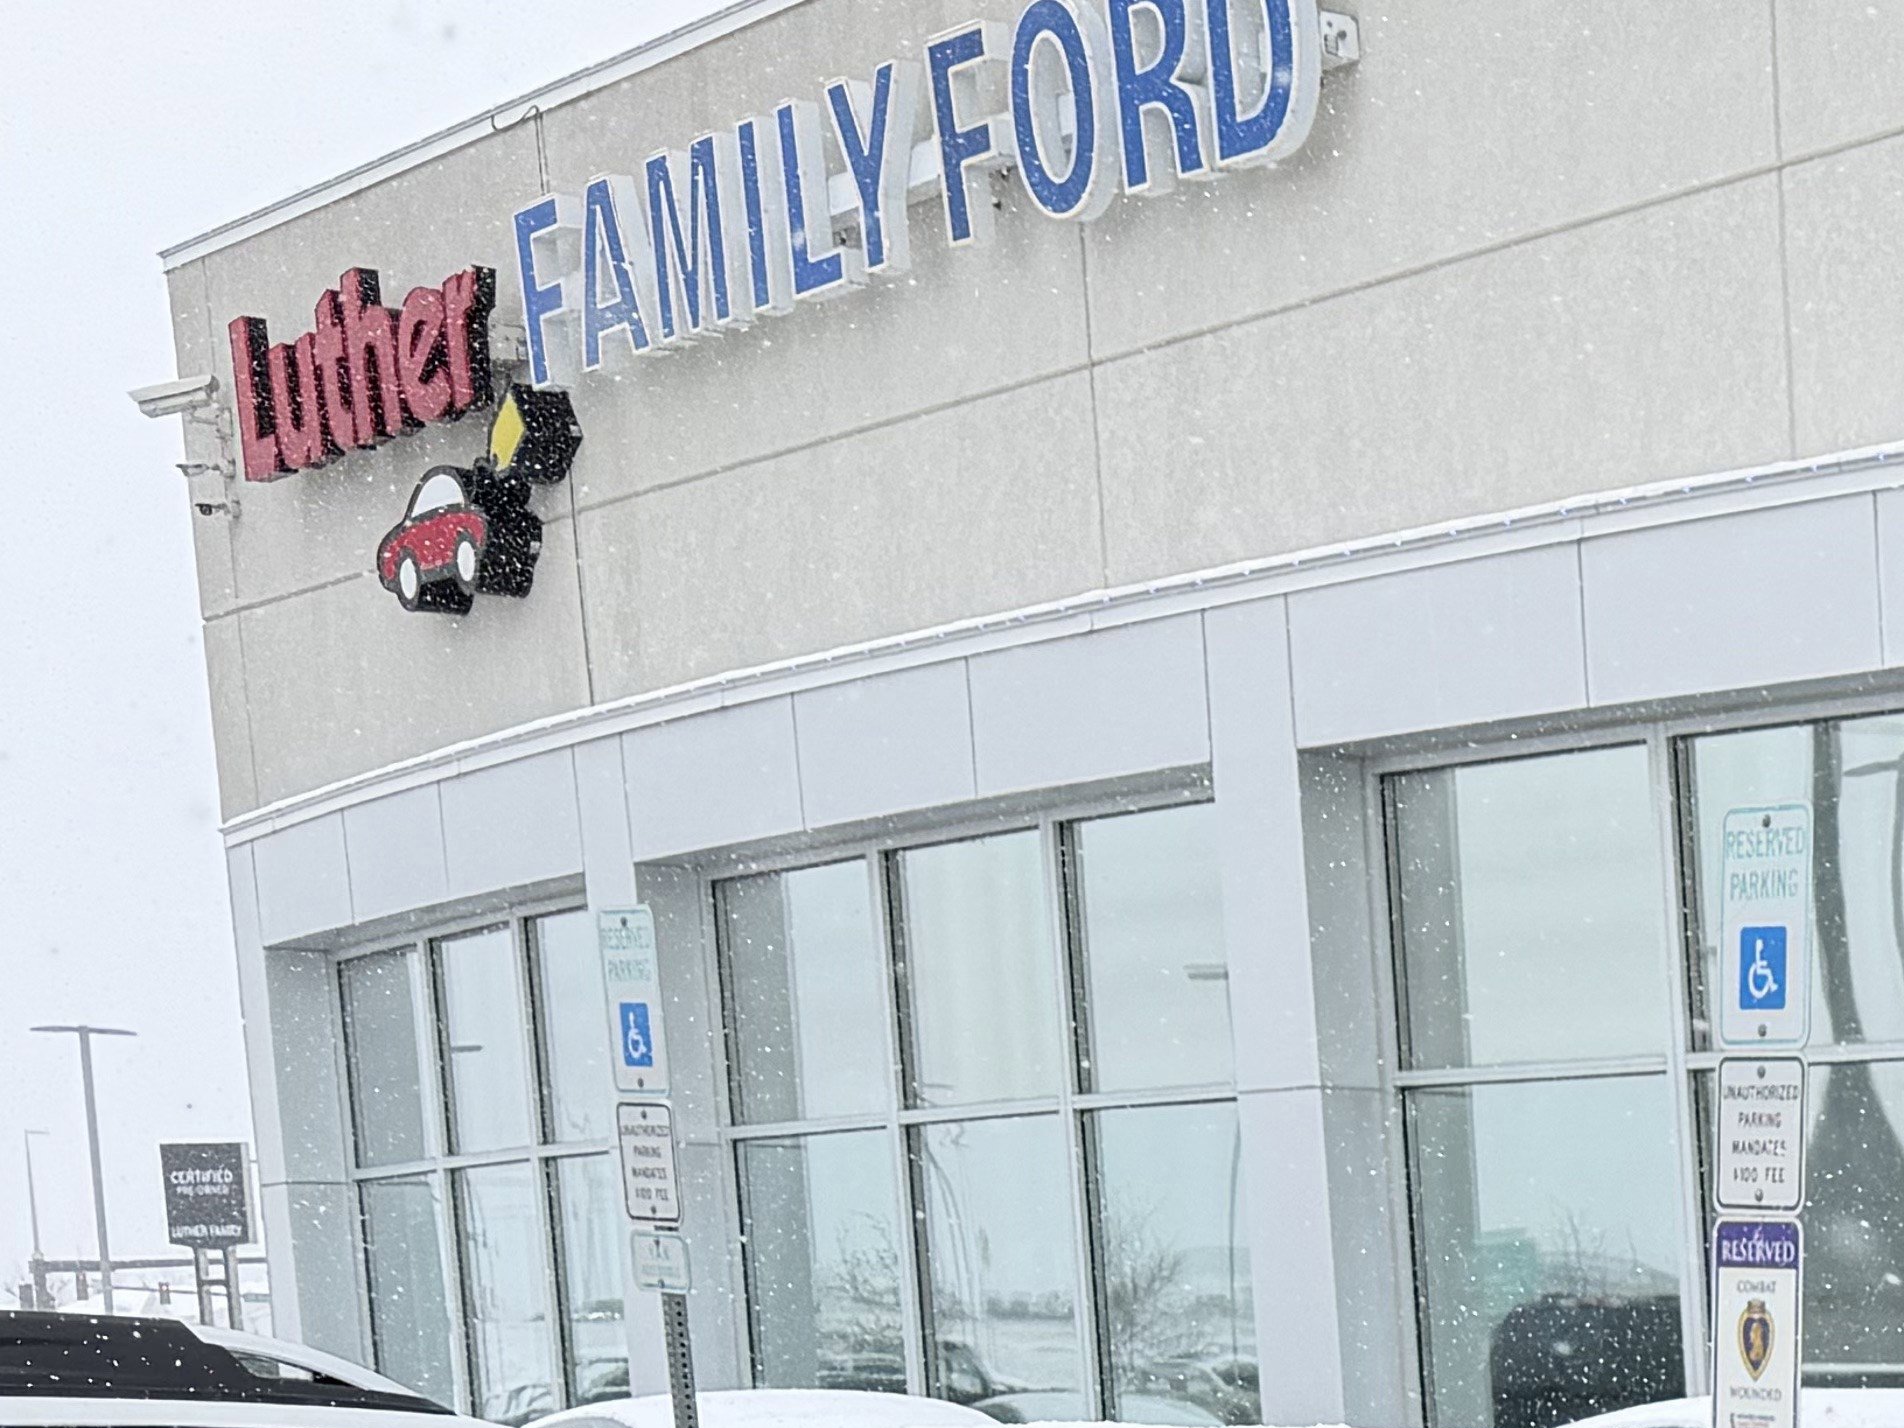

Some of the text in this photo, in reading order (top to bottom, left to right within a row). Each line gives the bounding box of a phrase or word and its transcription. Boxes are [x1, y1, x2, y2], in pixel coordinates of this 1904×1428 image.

[512, 0, 1308, 390] FAMILY FORD
[228, 265, 492, 482] Luther
[1726, 826, 1805, 859] RESERVED
[1730, 868, 1799, 900] PARKING
[1723, 1084, 1799, 1101] UNAUTHORIZED
[1739, 1111, 1782, 1128] PARKING
[1732, 1140, 1787, 1157] MANDATES
[1765, 1167, 1785, 1183] FEE
[1721, 1236, 1795, 1264] RESERVED
[1736, 1280, 1777, 1294] COMBAT
[1730, 1386, 1782, 1402] WOUNDED
